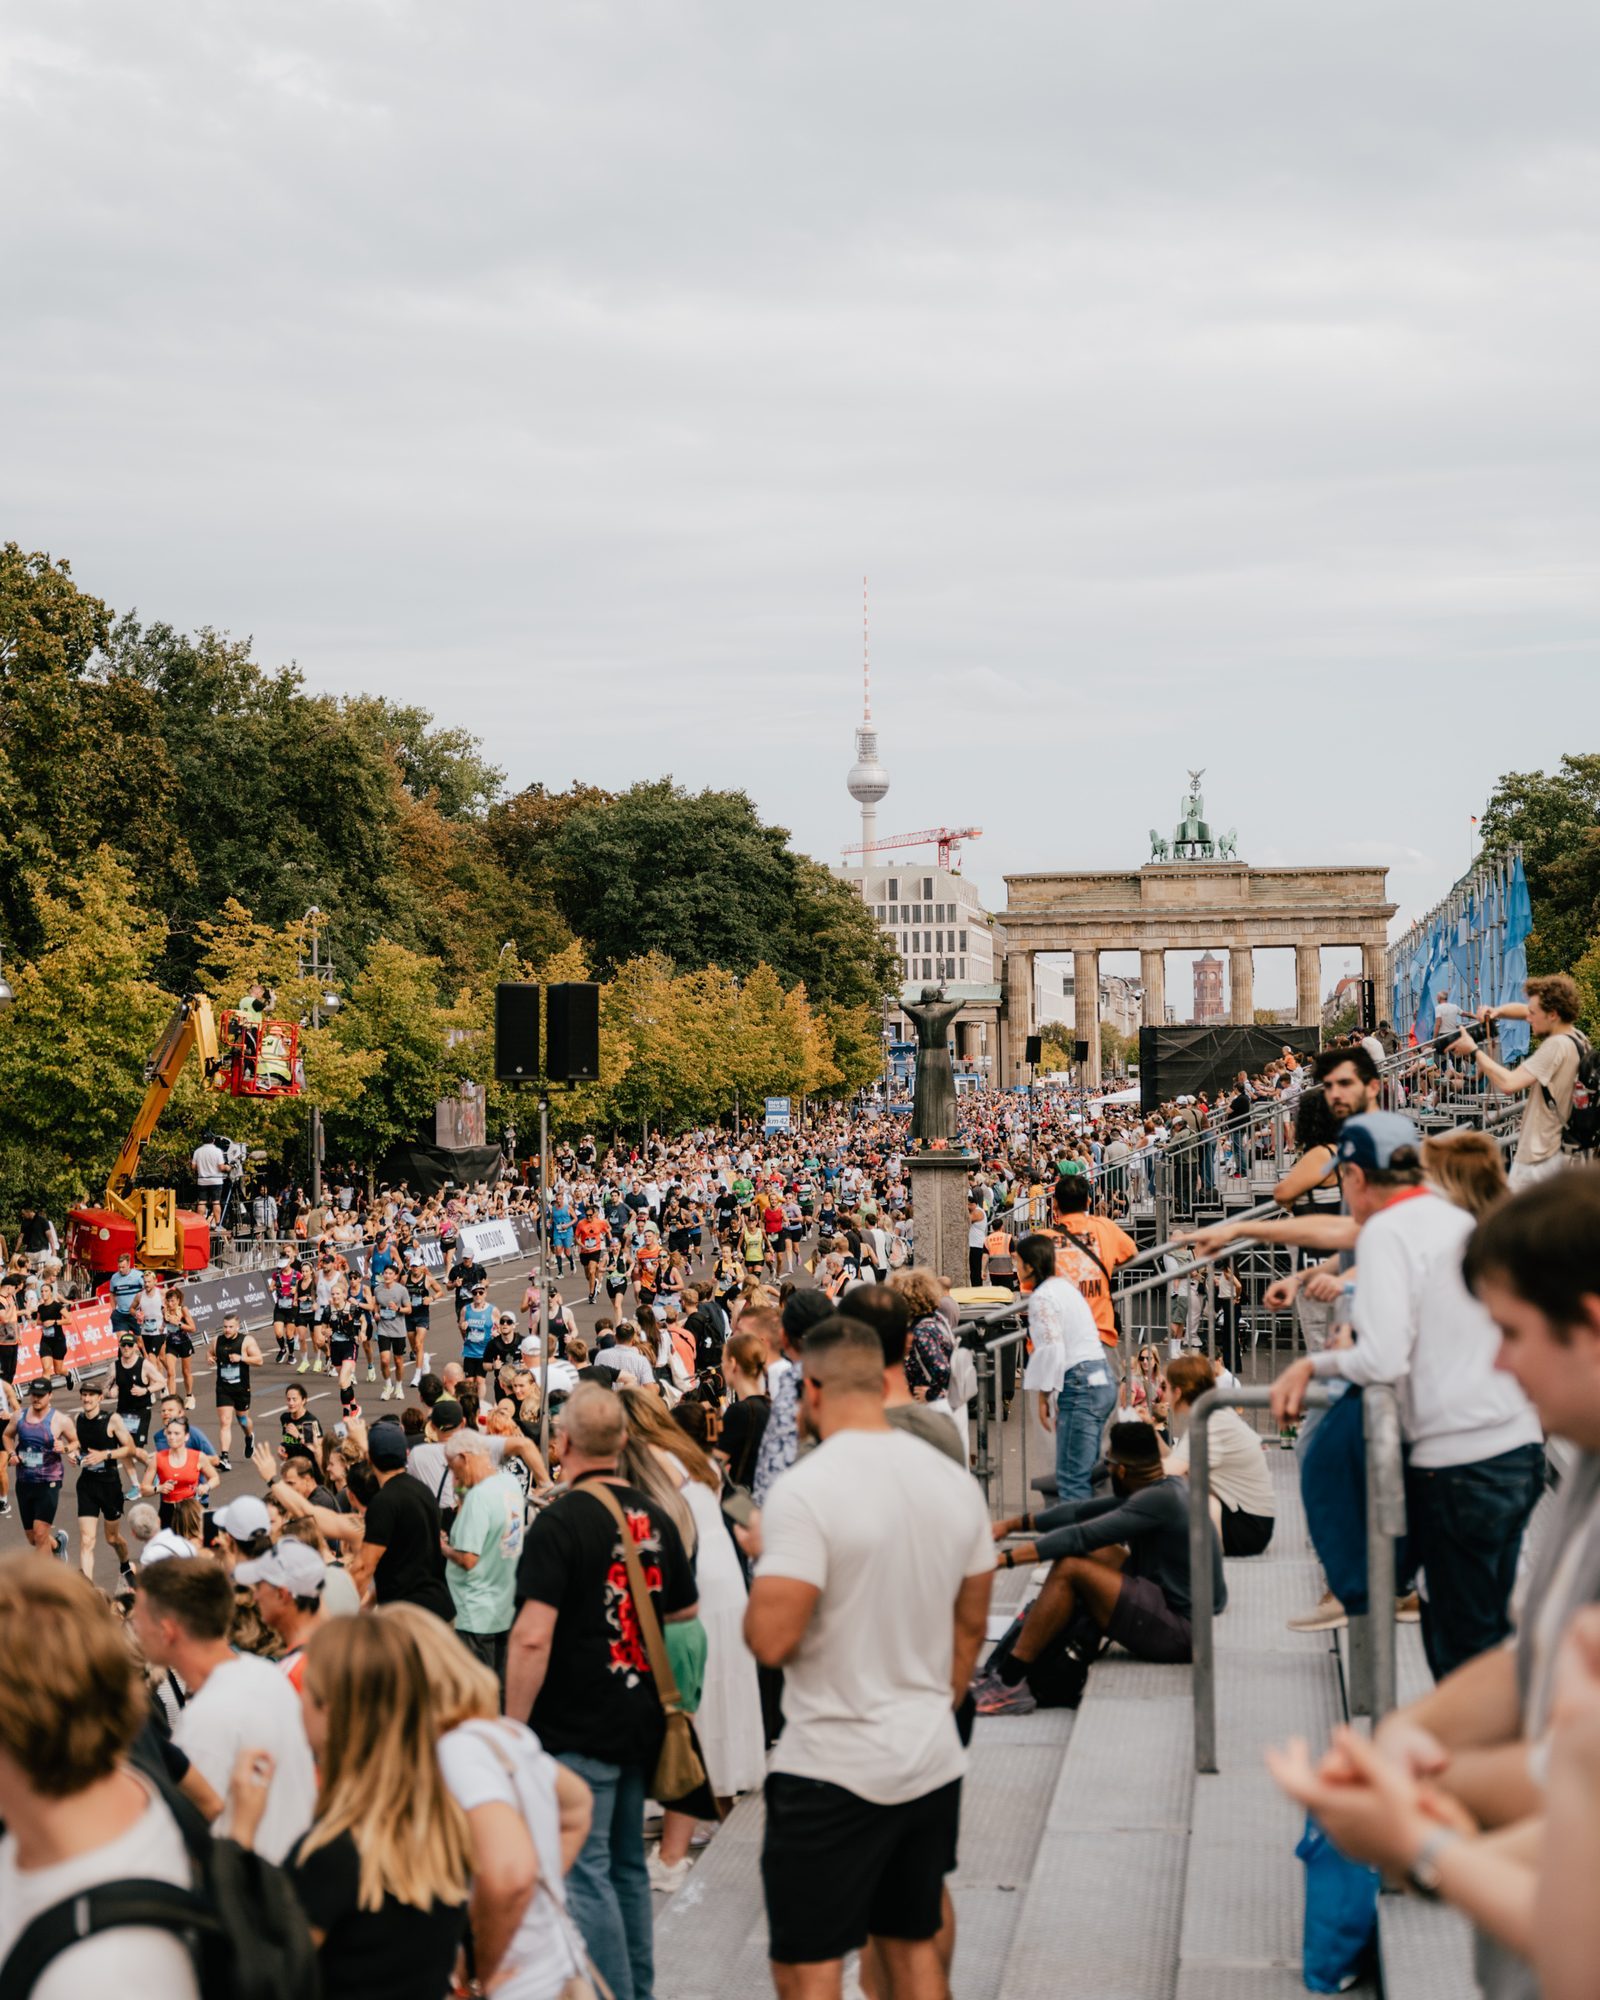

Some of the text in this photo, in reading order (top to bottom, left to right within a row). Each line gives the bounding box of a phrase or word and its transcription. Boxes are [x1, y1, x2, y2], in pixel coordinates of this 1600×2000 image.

[767, 1117, 788, 1125] km 42
[475, 1230, 505, 1251] SAMSUNG
[243, 1291, 266, 1303] NORQAIN
[216, 1297, 241, 1310] NORQAIN
